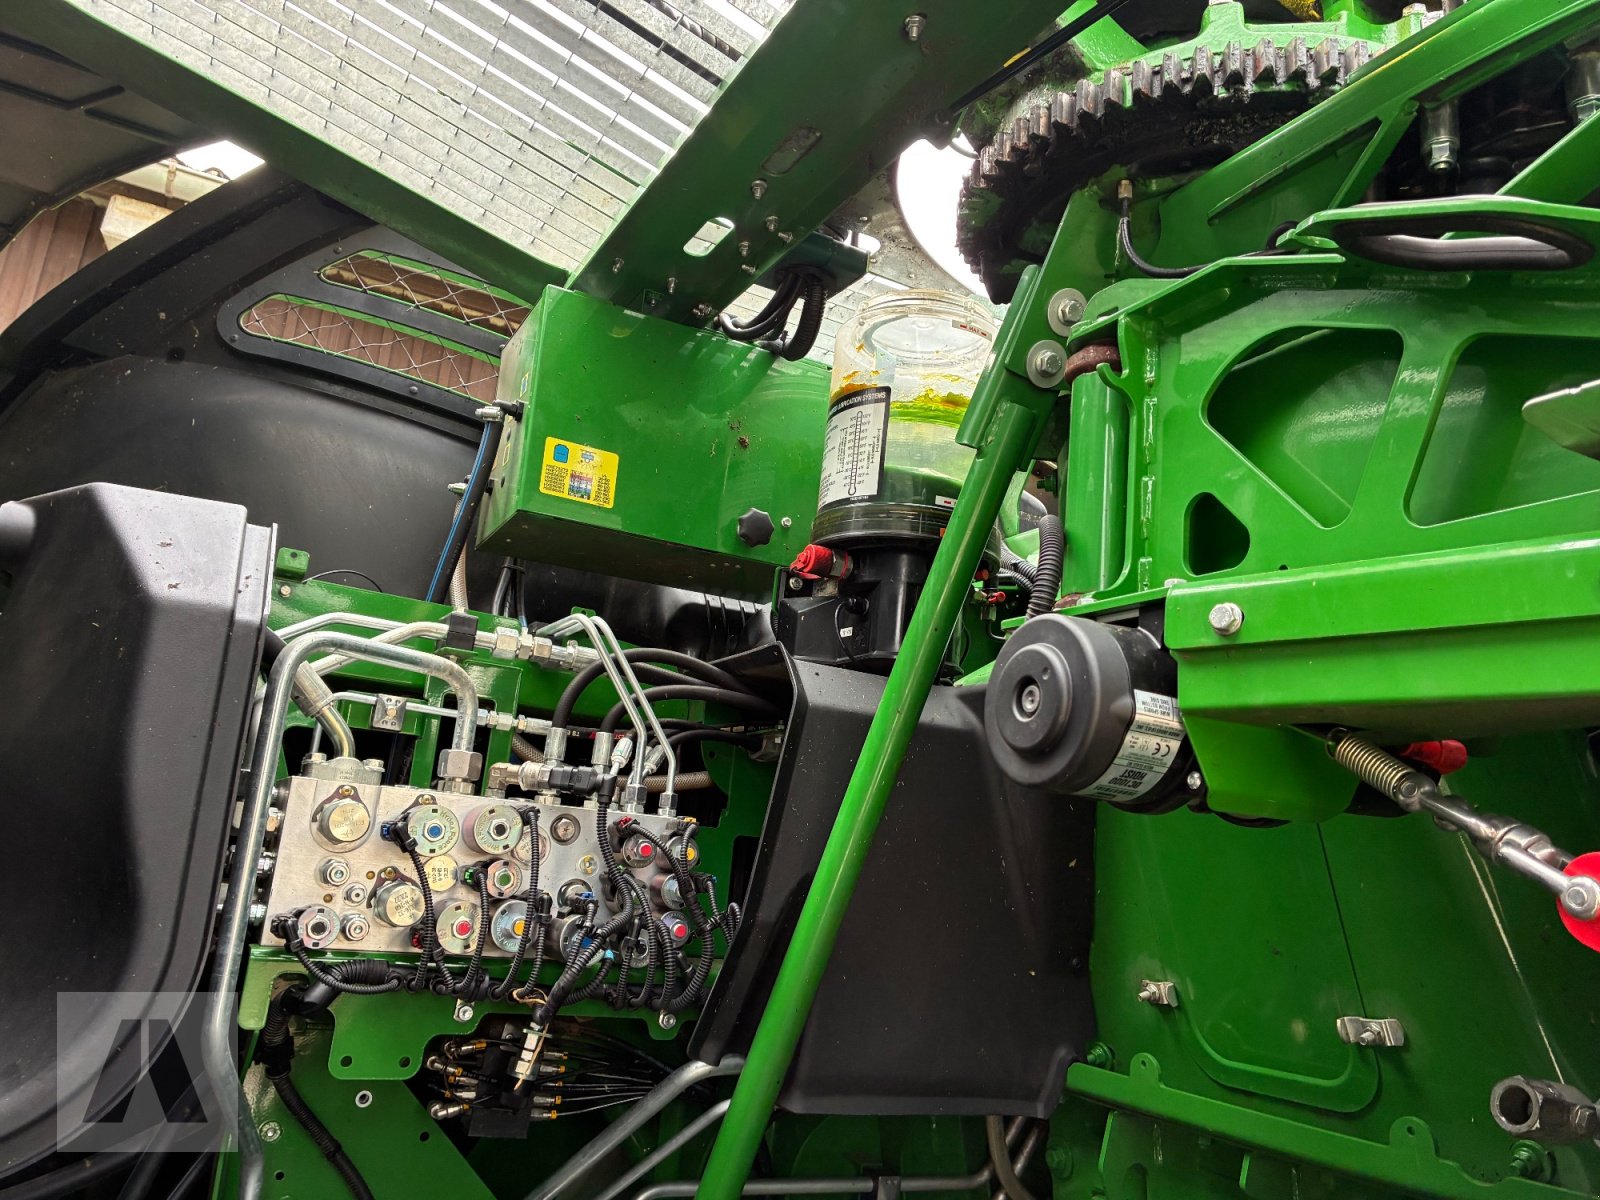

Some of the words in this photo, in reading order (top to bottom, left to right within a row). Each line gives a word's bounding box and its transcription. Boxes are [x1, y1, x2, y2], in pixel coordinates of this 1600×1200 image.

[838, 396, 862, 410] LUBRICATION
[863, 392, 886, 402] SYSTEMS
[1151, 742, 1171, 757] CE
[1120, 769, 1148, 780] HOIST
[1108, 777, 1143, 789] DC1000
